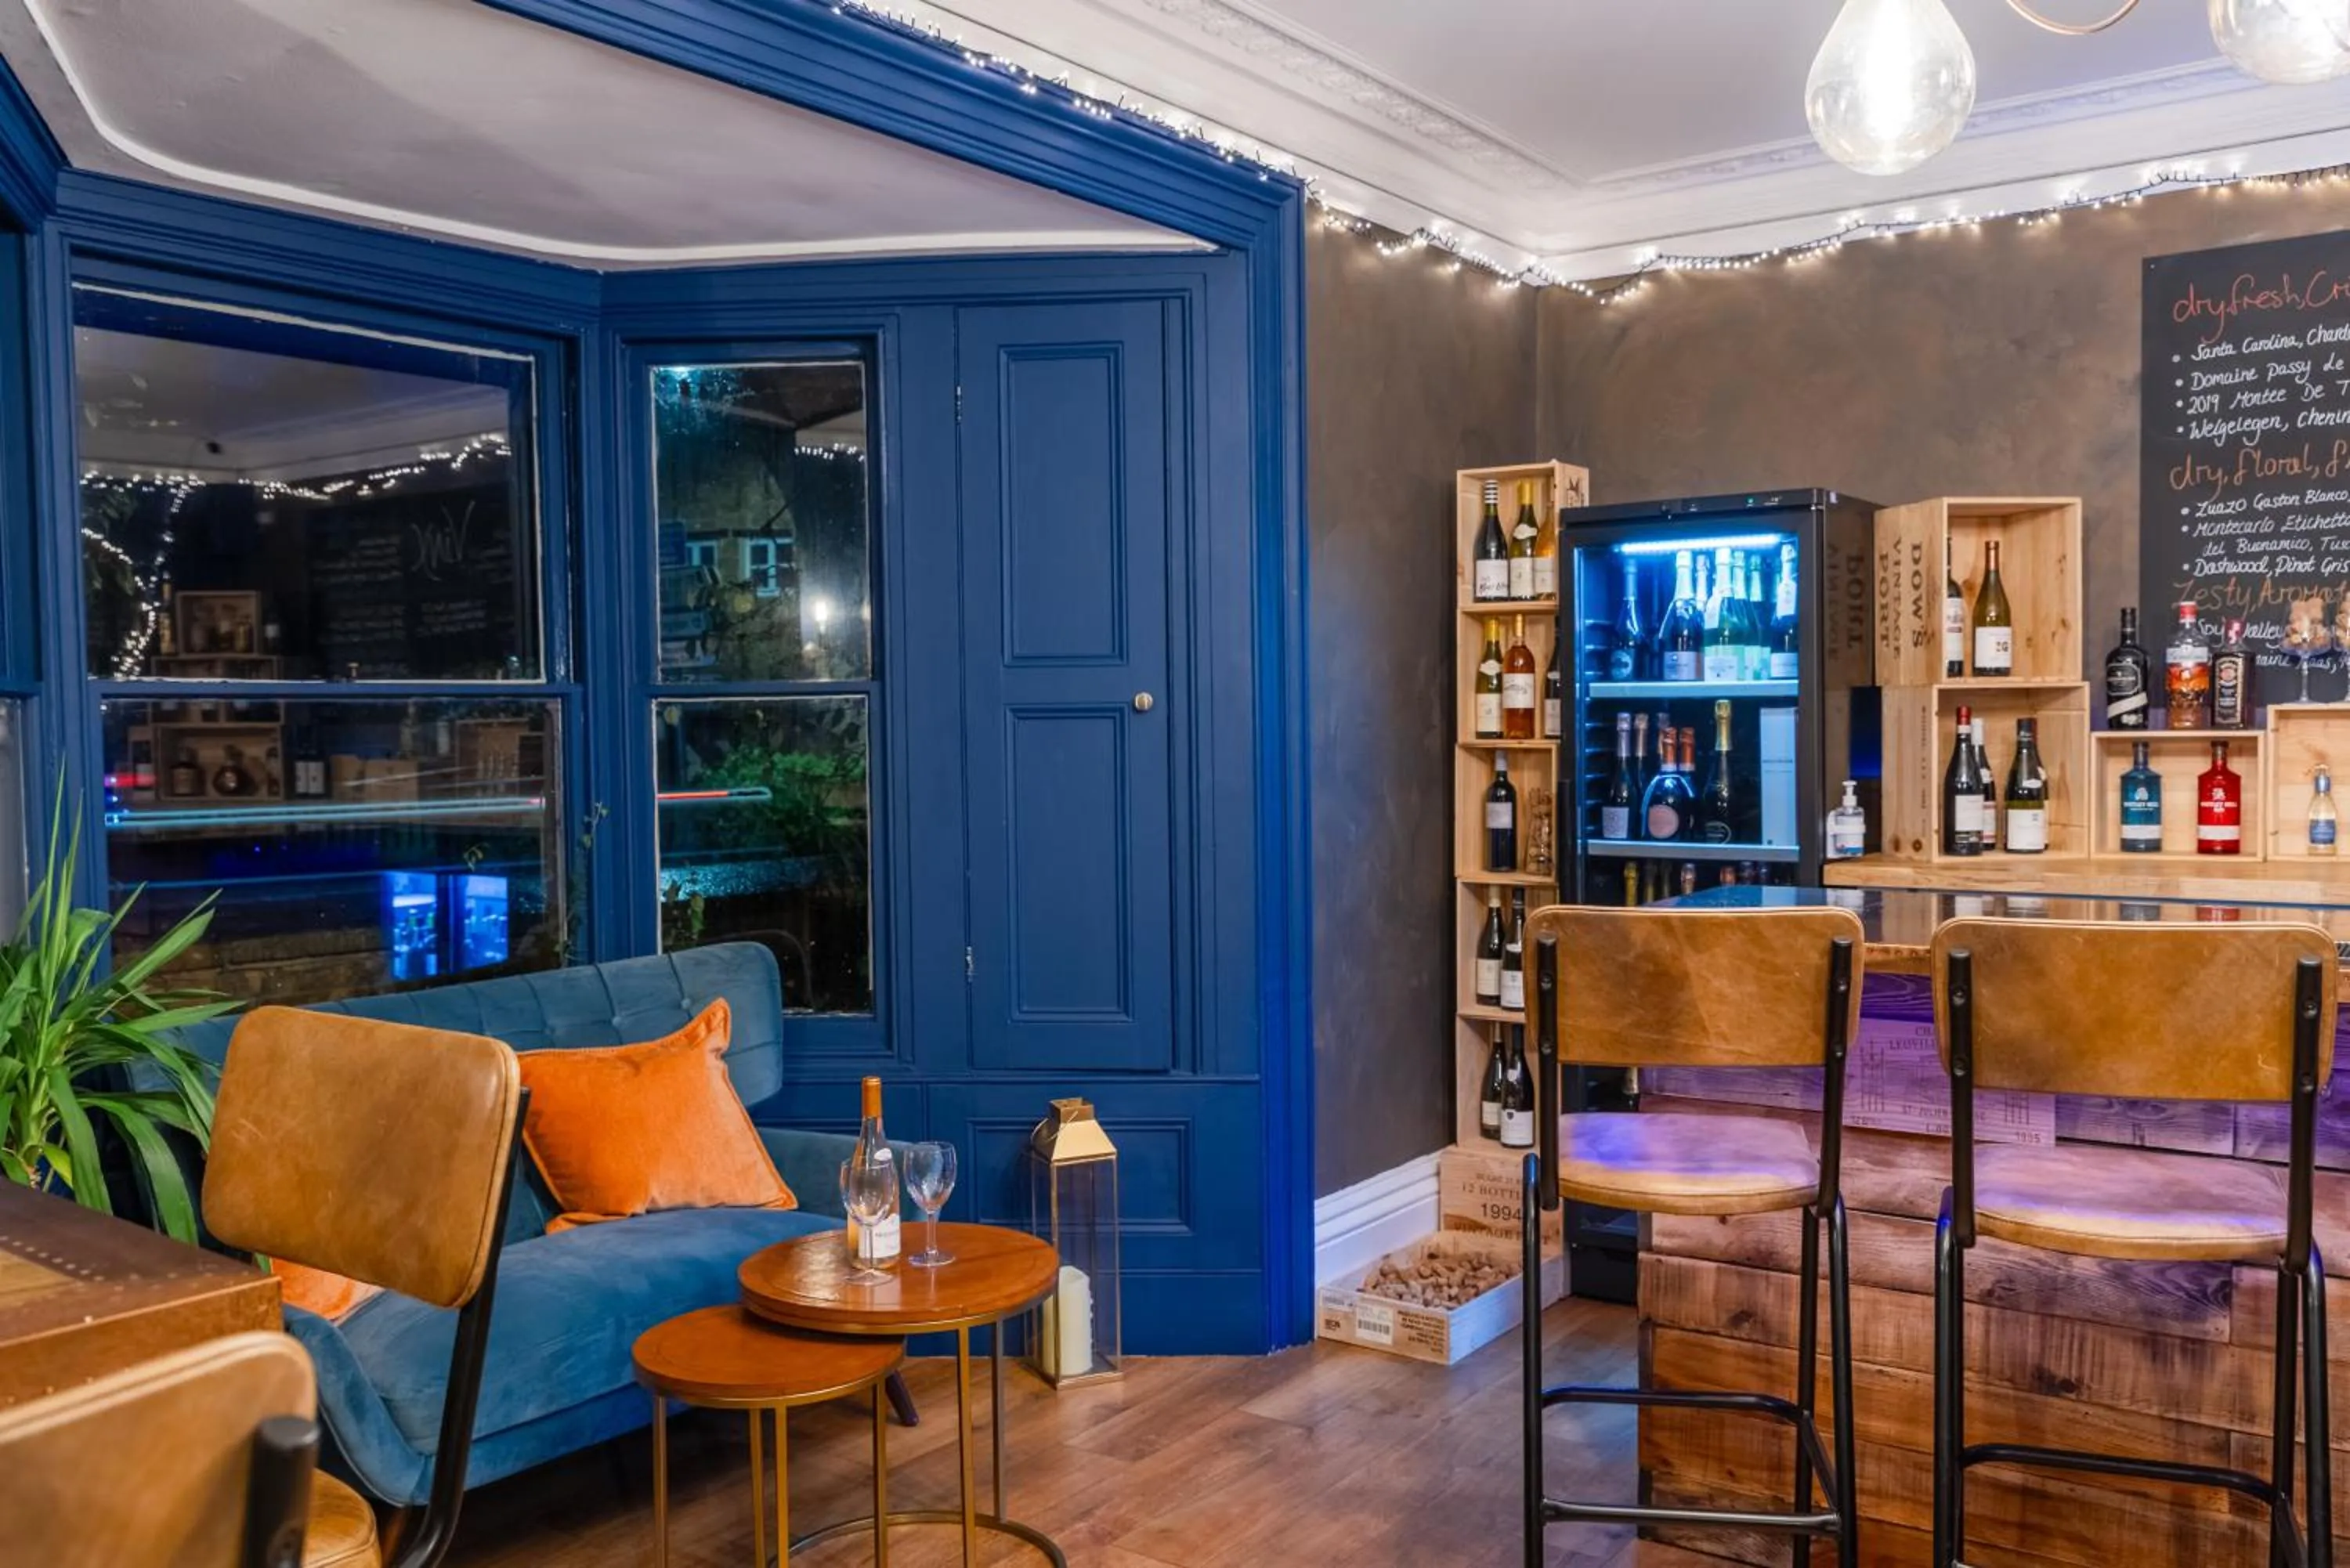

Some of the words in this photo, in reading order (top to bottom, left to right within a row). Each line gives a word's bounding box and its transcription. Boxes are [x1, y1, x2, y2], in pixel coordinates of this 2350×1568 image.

[2191, 341, 2236, 361] Santa
[2190, 367, 2258, 391] Domaine
[2187, 393, 2220, 414] 2019
[2300, 381, 2326, 403] De
[2297, 406, 2350, 429] Chenin
[2233, 443, 2320, 486] floral,
[2253, 492, 2300, 511] Gaston
[2193, 515, 2276, 537] Montecarlo
[2203, 541, 2225, 557] del
[2320, 557, 2350, 577] Gris
[1879, 551, 1889, 648] PORT
[1893, 536, 1902, 660] VINTAGE
[1911, 542, 1924, 649] DOW'S
[1480, 1202, 1523, 1221] 1994
